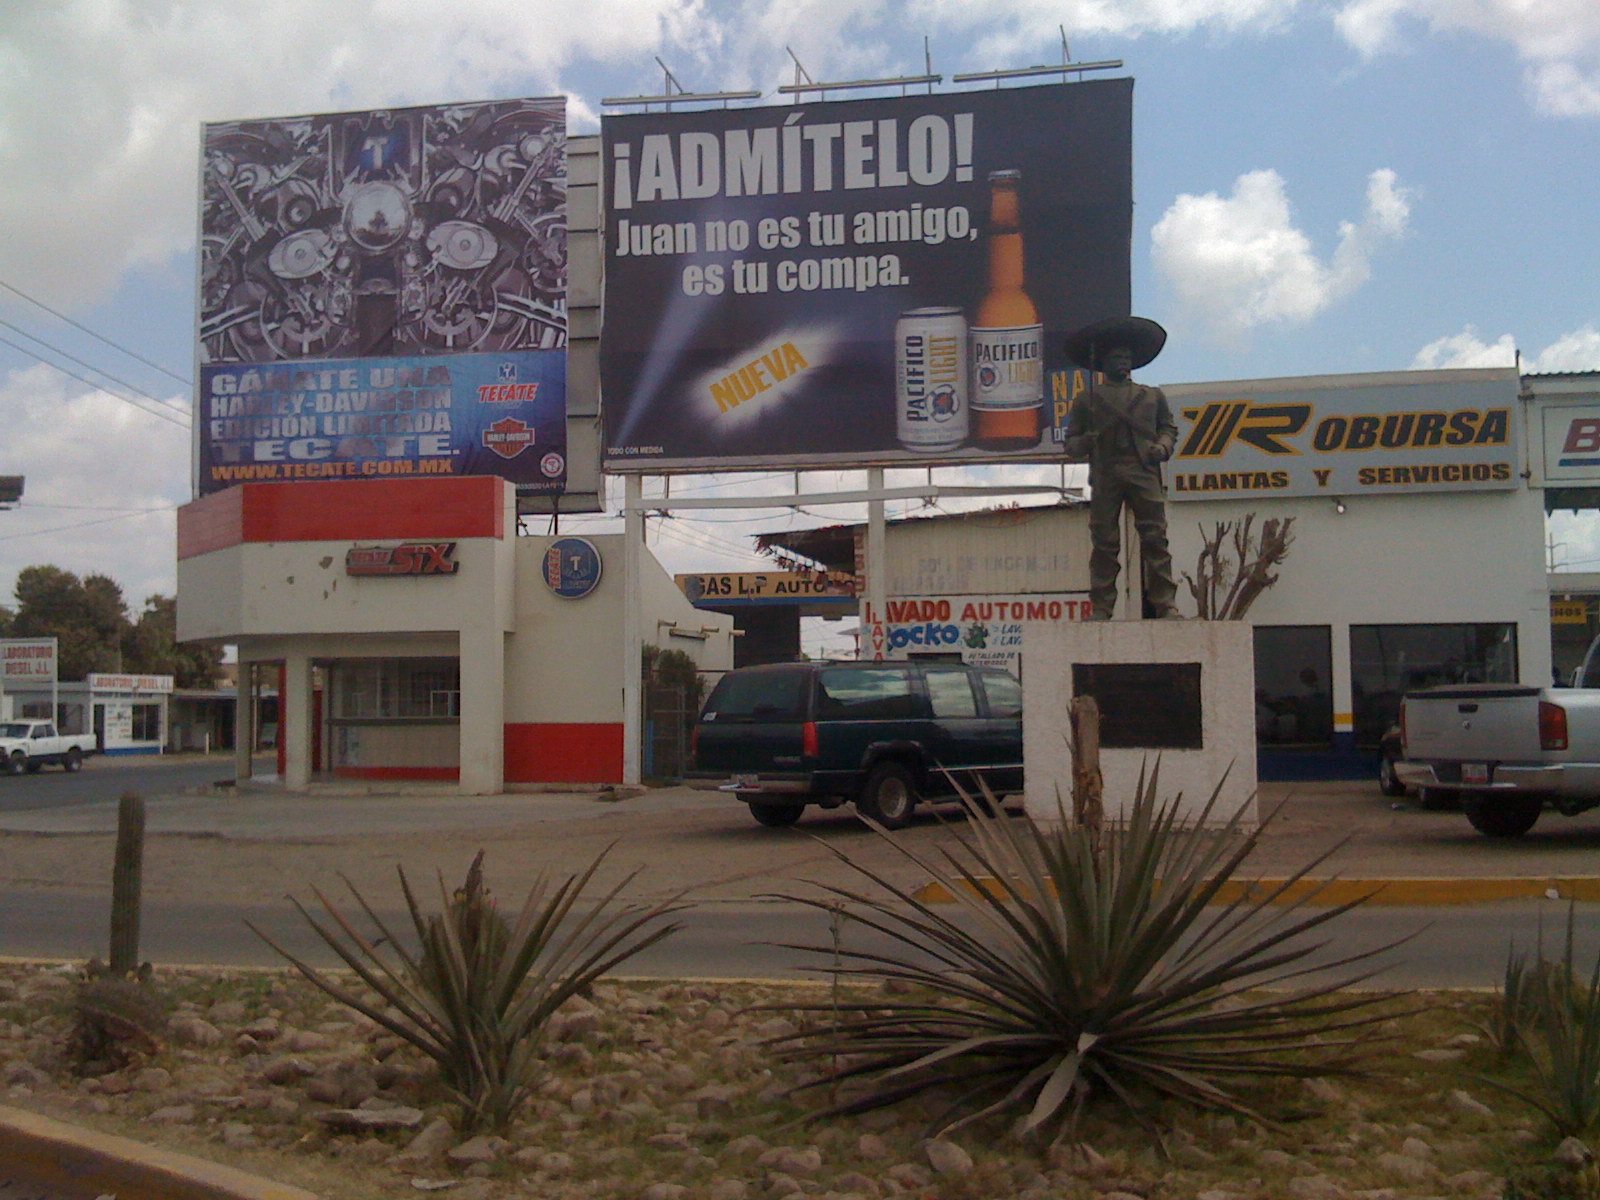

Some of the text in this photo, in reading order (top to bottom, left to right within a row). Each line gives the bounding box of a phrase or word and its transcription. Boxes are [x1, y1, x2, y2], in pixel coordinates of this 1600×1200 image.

[613, 112, 975, 210] ¡ADMÍTELO!
[615, 203, 978, 257] Juan no es tu amigo,
[682, 253, 909, 297] es tu compa.
[976, 341, 1038, 363] PACIFICO
[211, 365, 452, 395] GÁNATE UNA
[477, 383, 540, 403] TECATE
[708, 341, 809, 414] NUEVA
[905, 335, 929, 422] PACIFICO
[323, 411, 452, 436] LIMITADA
[1174, 463, 1512, 493] LLANTAS Y SERVICIOS
